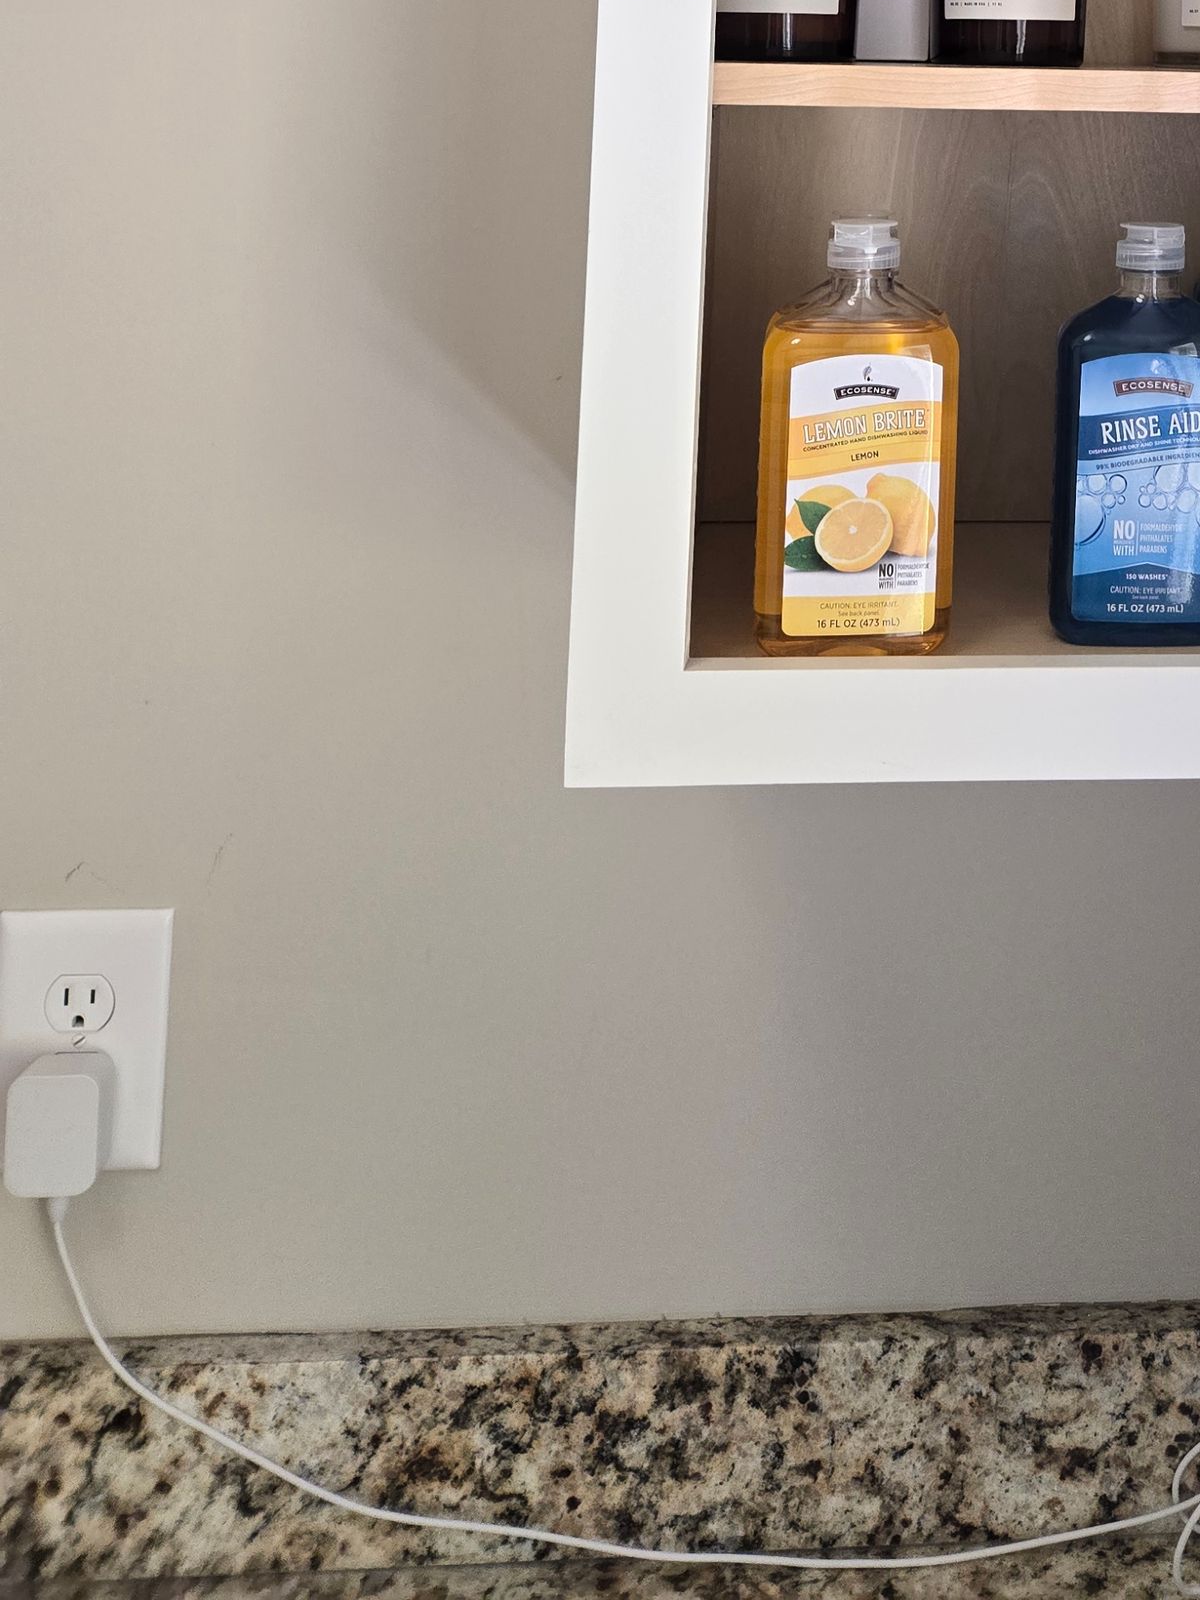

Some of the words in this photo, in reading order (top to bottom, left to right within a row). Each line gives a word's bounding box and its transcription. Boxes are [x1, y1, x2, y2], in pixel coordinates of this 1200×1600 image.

[803, 415, 867, 444] LEMON
[873, 408, 925, 432] BRITE
[1100, 415, 1161, 444] RINSE
[803, 440, 849, 452] CONCENTRATED
[867, 431, 908, 441] DISHWASHING
[1088, 445, 1128, 455] DISHWASHER
[851, 450, 879, 462] LEMON
[1110, 455, 1164, 469] BIODEGRADABLE
[1113, 520, 1136, 540] NO
[1113, 545, 1135, 556] WITH
[1139, 545, 1168, 554] PARABENS
[879, 563, 894, 577] NO
[879, 581, 894, 589] WITH
[1110, 586, 1141, 594] CAUTION:
[1142, 586, 1153, 594] EYE
[1107, 604, 1115, 612] 16
[1118, 604, 1128, 612] FL
[1131, 604, 1144, 612] OZ
[1146, 604, 1165, 613] (473
[1167, 604, 1184, 613] mL)
[817, 619, 827, 628] 16
[830, 619, 840, 628] FL
[844, 619, 857, 627] OZ
[860, 619, 879, 628] (473
[882, 618, 900, 627] mL)
